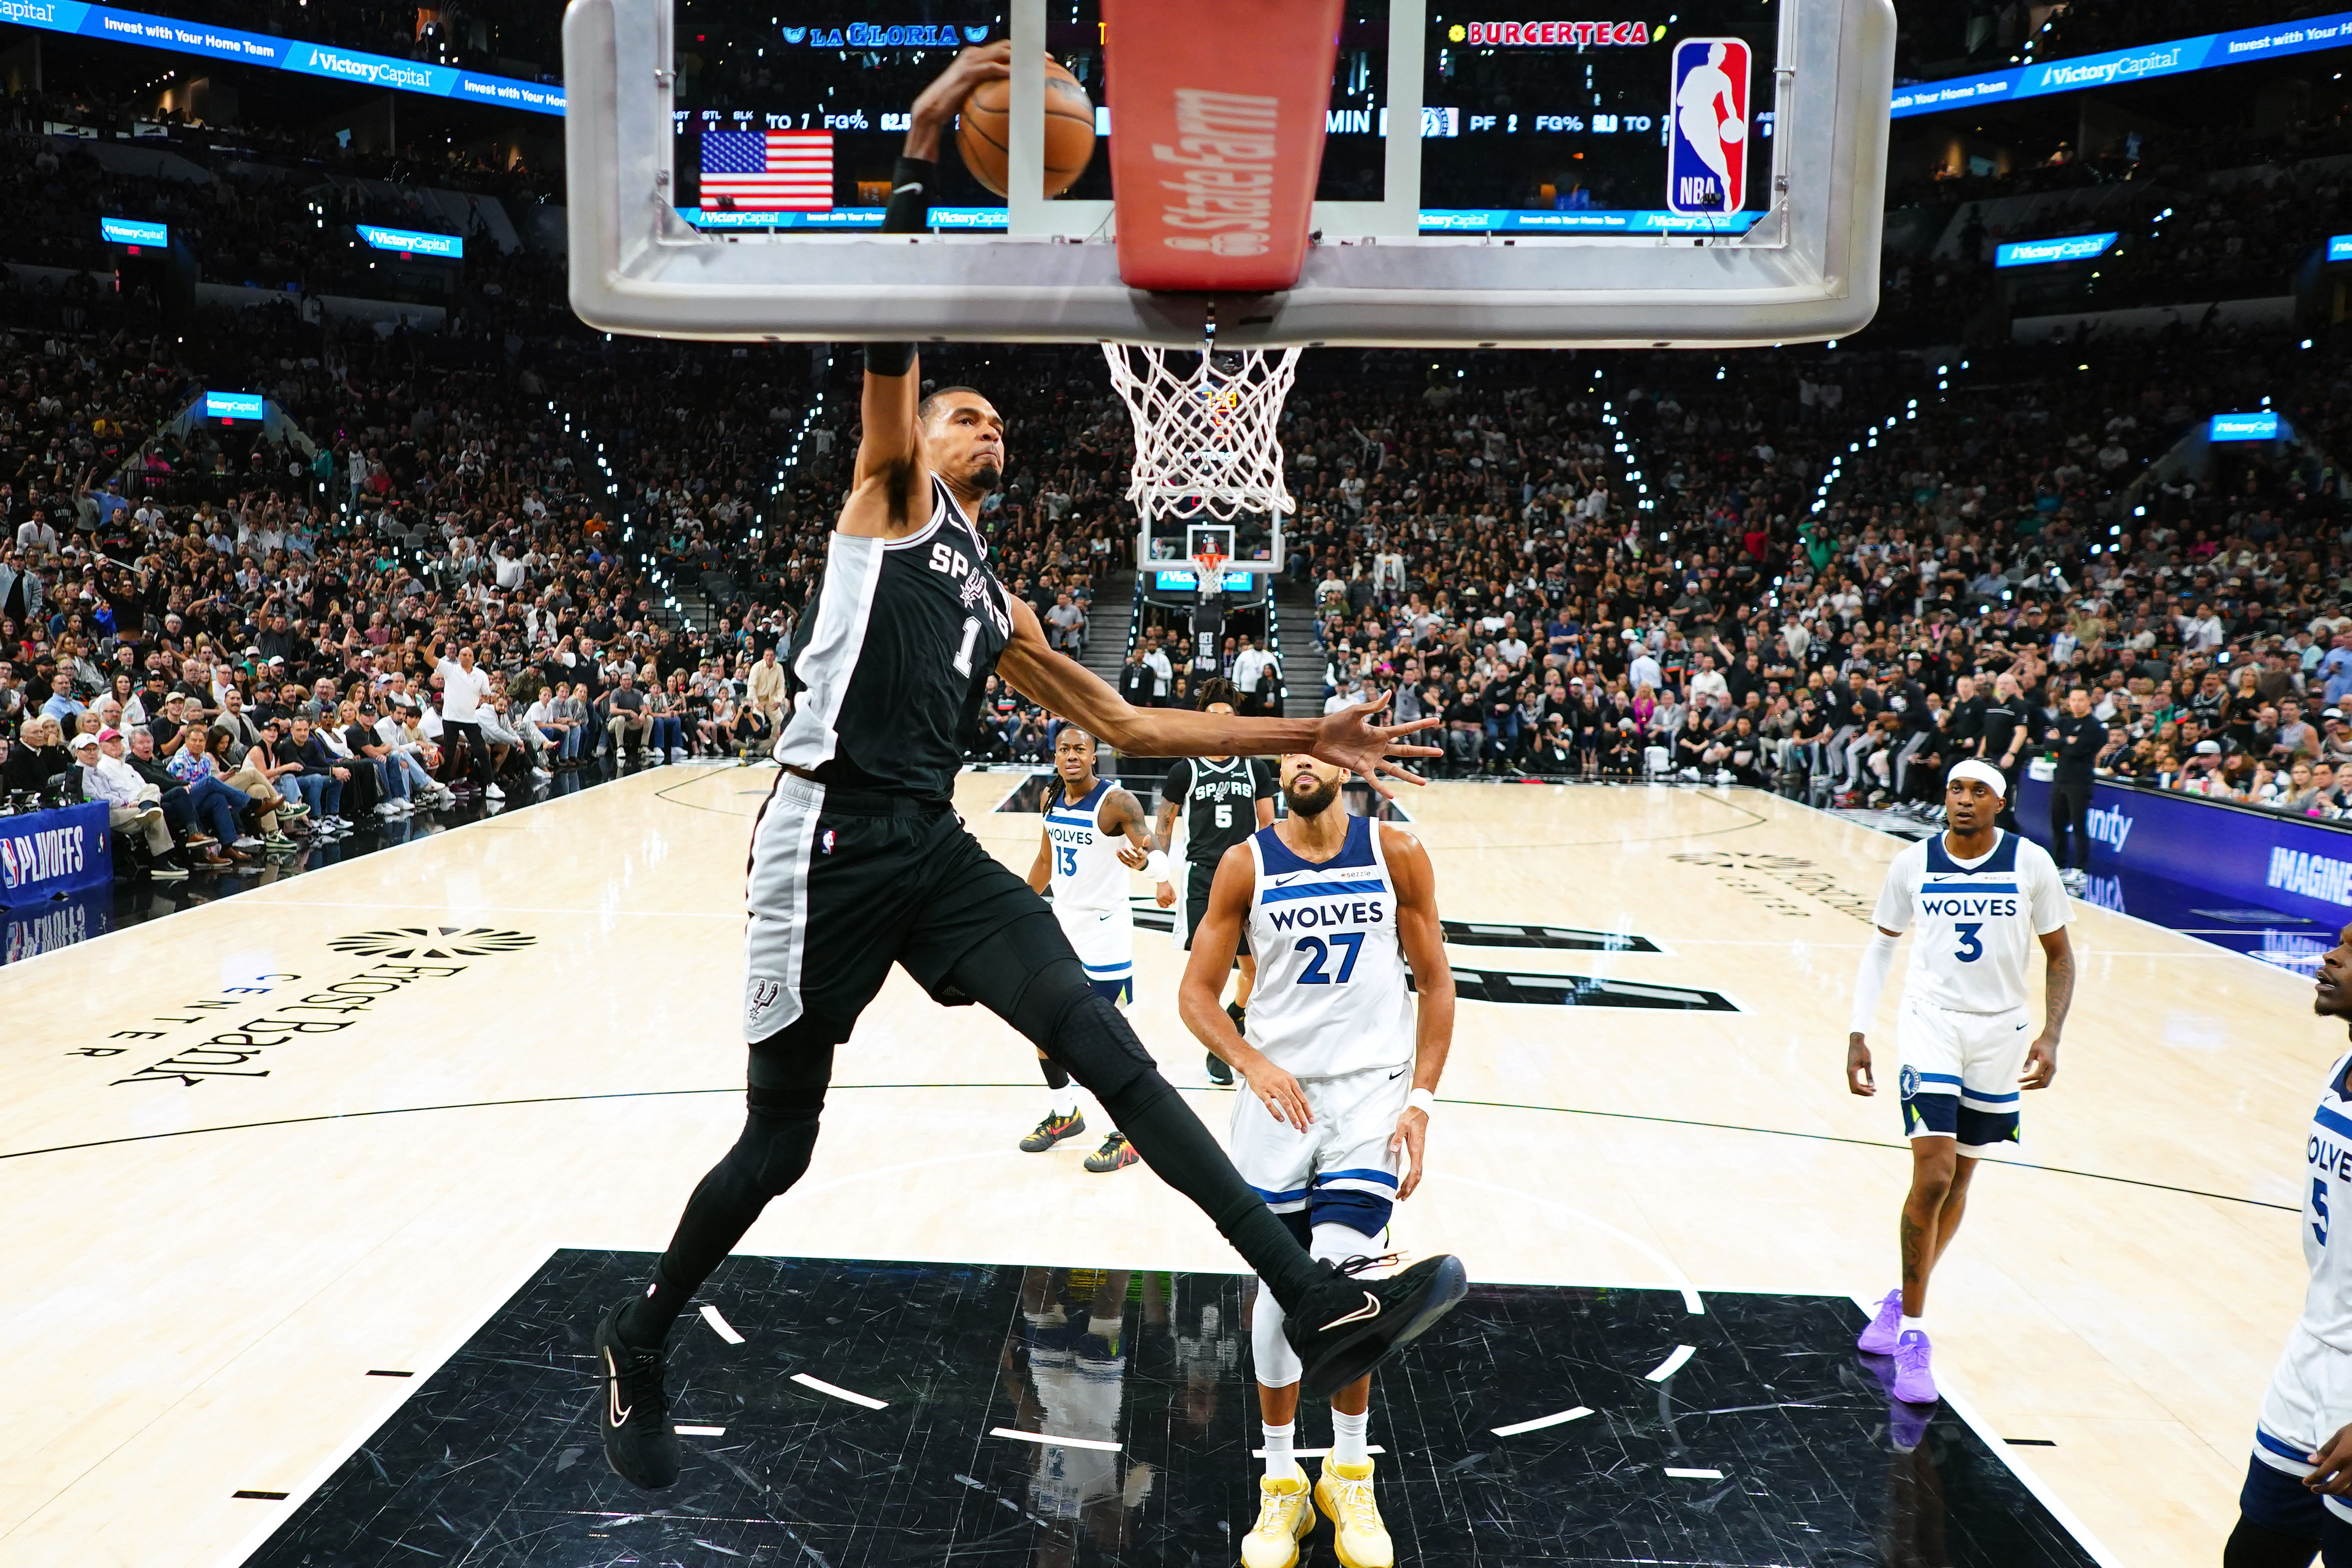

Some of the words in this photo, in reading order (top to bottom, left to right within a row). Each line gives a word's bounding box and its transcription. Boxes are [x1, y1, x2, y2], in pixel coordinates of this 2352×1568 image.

[0, 1, 54, 22] apital
[104, 16, 143, 35] Invest
[145, 26, 172, 40] with
[175, 29, 203, 45] Your
[206, 34, 241, 52] Home
[243, 41, 274, 57] Team
[810, 29, 844, 47] LA
[846, 22, 960, 46] GLORIA
[1468, 22, 1649, 45] BURGERTECA
[2229, 36, 2271, 54] Invest
[2273, 31, 2303, 46] with
[2305, 26, 2338, 41] Your
[465, 80, 496, 96] Invest
[498, 86, 520, 99] with
[521, 89, 544, 104] Your
[546, 92, 568, 108] Hom
[1913, 91, 1940, 105] Your
[1941, 86, 1975, 100] Home
[1976, 81, 2008, 95] Team
[768, 115, 792, 129] TO
[824, 114, 869, 130] FG%
[1325, 110, 1370, 134] MIN
[1470, 115, 1497, 132] PF
[1535, 115, 1584, 133] FG%
[1622, 116, 1651, 132] TO
[1680, 177, 1716, 204] NBA
[953, 615, 982, 678] 1
[1215, 804, 1232, 828] 5
[1046, 827, 1093, 845] WOLVES
[14, 825, 83, 885] PLAYOFFS
[1056, 845, 1077, 877] 13
[2267, 846, 2352, 907] IMAGINE
[1269, 901, 1383, 932] WOLVES
[1922, 900, 2017, 916] WOLVES
[1954, 923, 1983, 962] 3
[1294, 932, 1365, 984] 27
[2307, 1134, 2352, 1183] OLVE
[2312, 1177, 2329, 1247] 5
